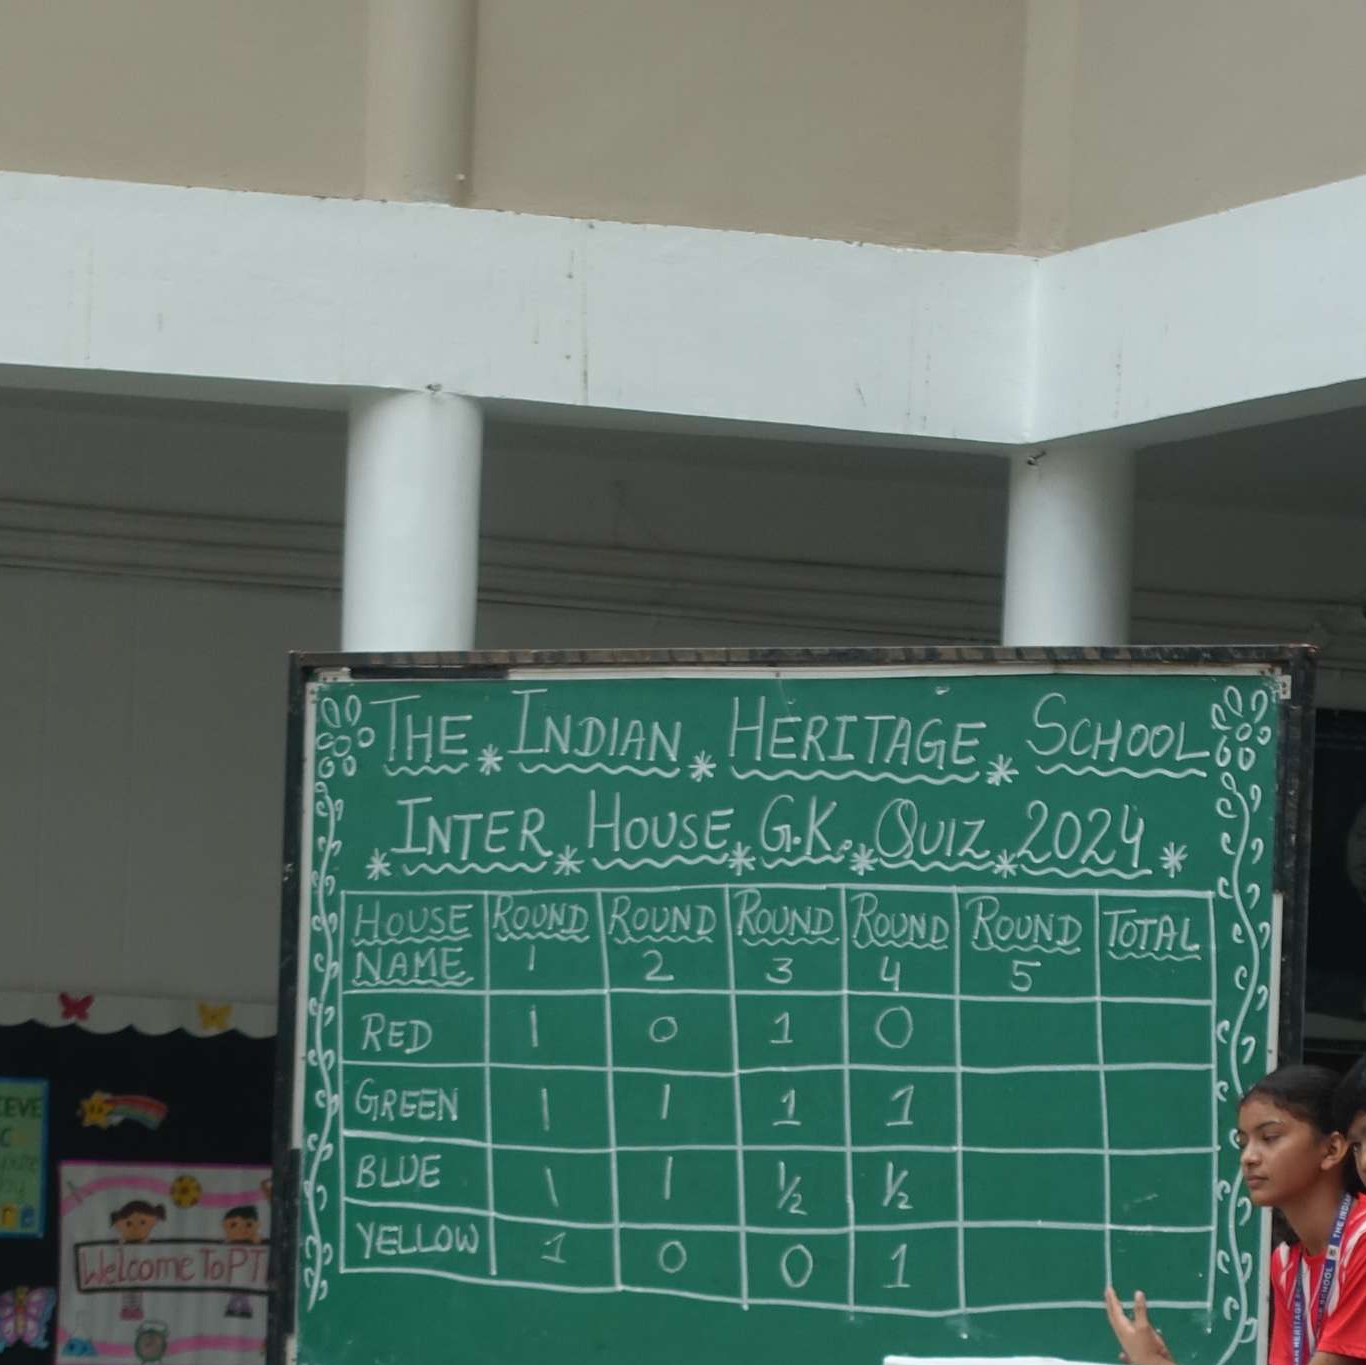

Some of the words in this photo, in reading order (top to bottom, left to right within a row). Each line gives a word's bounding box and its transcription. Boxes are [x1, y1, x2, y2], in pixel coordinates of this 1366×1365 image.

[370, 695, 473, 763] THE
[507, 688, 682, 762] INDIAN
[729, 696, 986, 769] HERITAGE
[1026, 693, 1211, 762] SCHOOL
[390, 797, 554, 860] INTER
[587, 790, 734, 852] HOUSE
[875, 798, 992, 860] QUIZ
[1016, 801, 1145, 868] 2024
[354, 901, 473, 938] HOUSE
[492, 895, 590, 934] ROUND
[608, 895, 718, 937] ROUND
[736, 890, 835, 937] ROUND
[850, 892, 950, 944] ROUND
[965, 896, 1083, 948] ROUND
[1103, 909, 1201, 951] TOTAL
[354, 947, 467, 981] NAME
[642, 949, 675, 981] 2
[766, 958, 794, 984] 3
[880, 956, 902, 991] 4
[1010, 961, 1042, 992] 5
[361, 1012, 434, 1054] RED
[770, 1012, 794, 1045] 1
[354, 1078, 459, 1122] GREEN
[773, 1089, 802, 1126] 1
[886, 1084, 915, 1127] 1
[355, 1154, 443, 1189] BLUE
[81, 1247, 195, 1286] Welcome
[356, 1221, 480, 1260] YELLOW
[540, 1232, 567, 1264] 1
[882, 1243, 912, 1288] 1
[1294, 1301, 1303, 1346] HERITAGE
